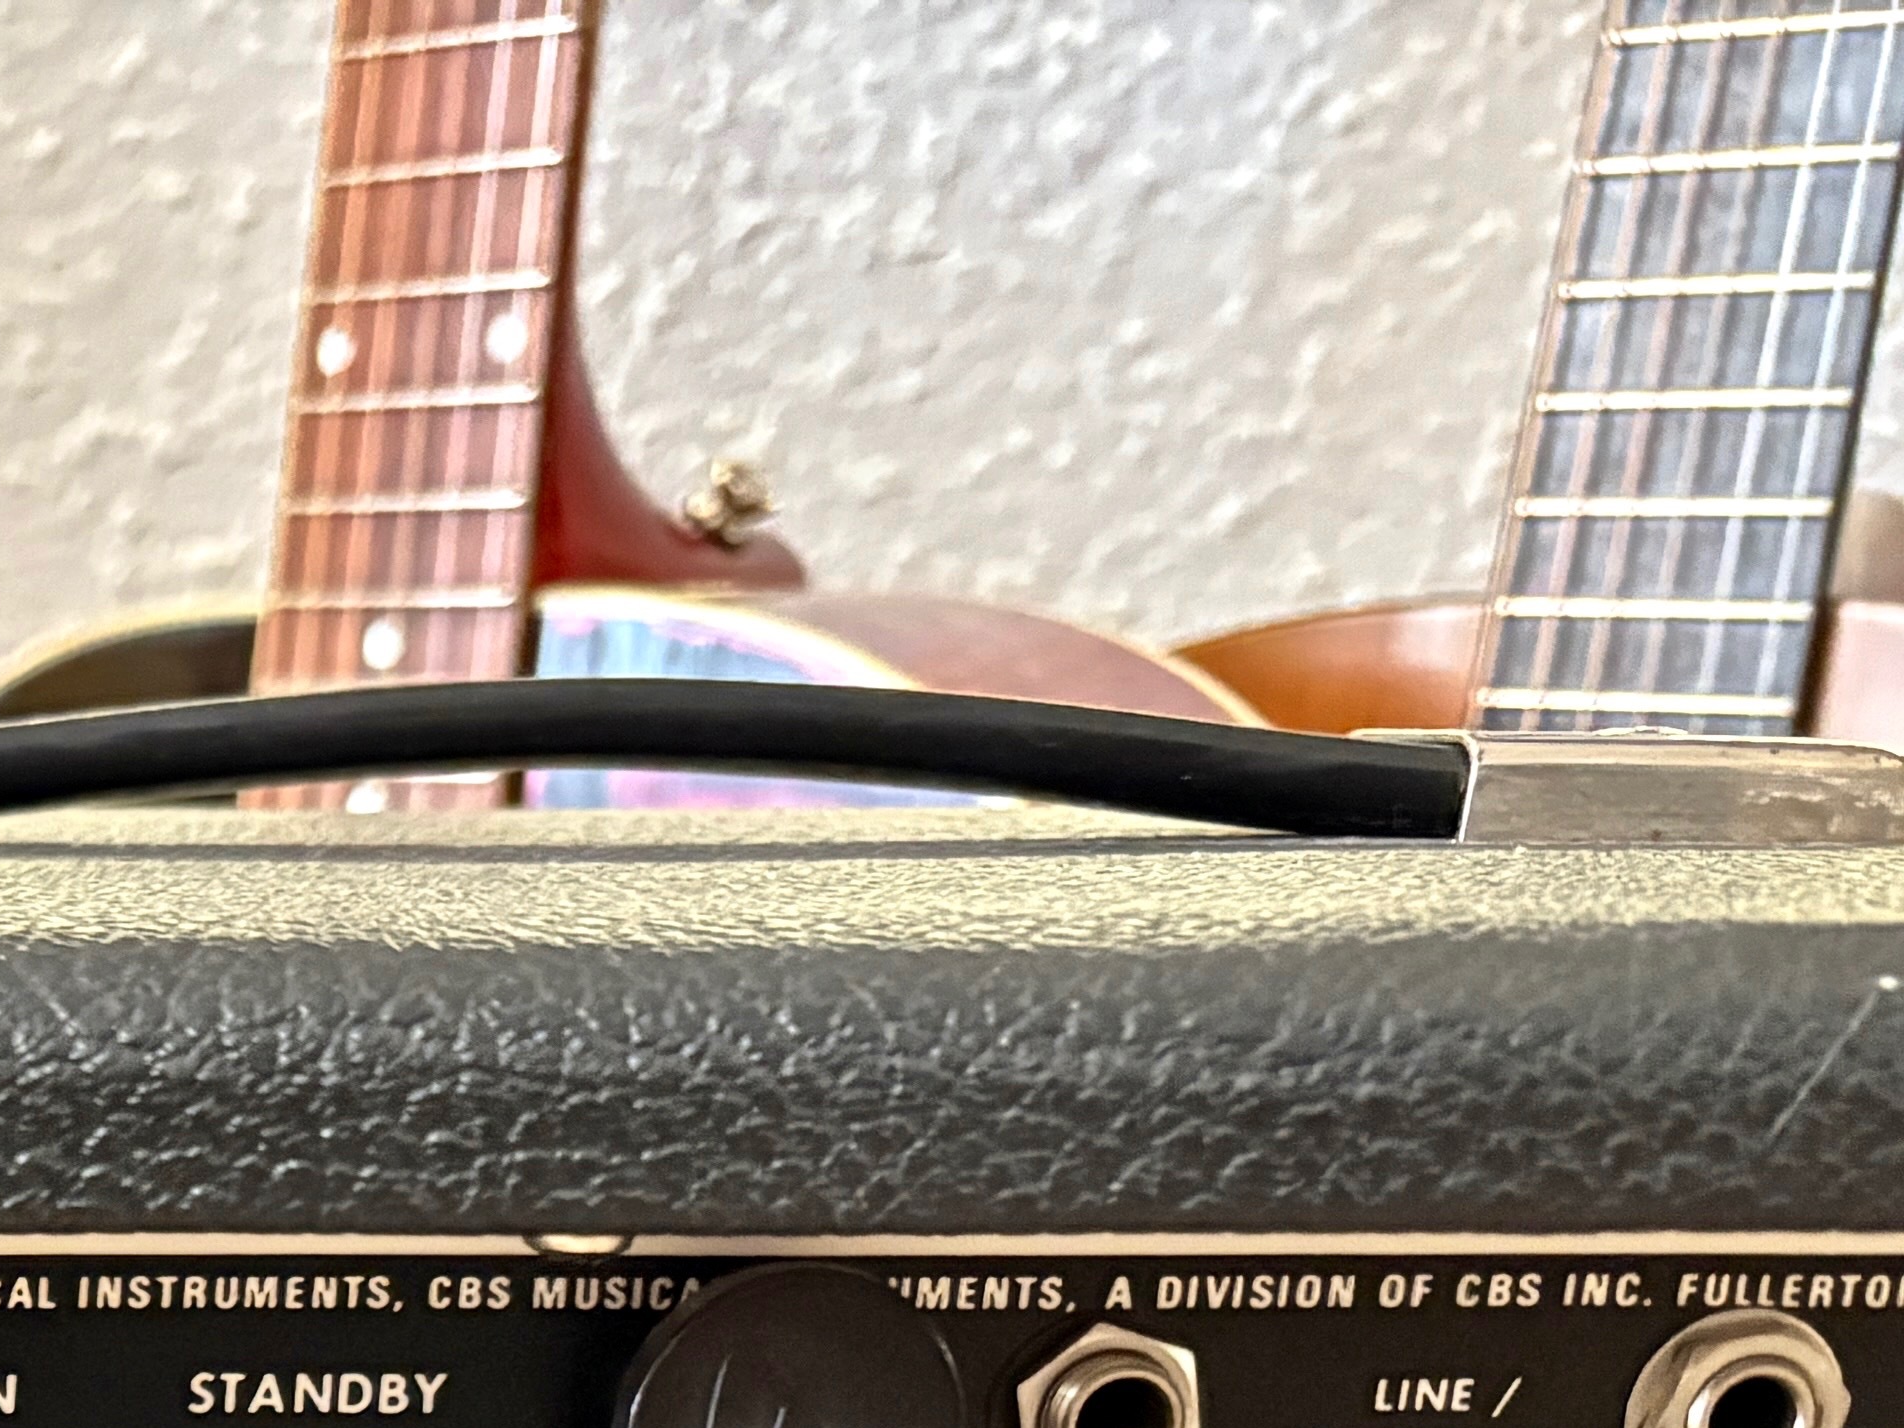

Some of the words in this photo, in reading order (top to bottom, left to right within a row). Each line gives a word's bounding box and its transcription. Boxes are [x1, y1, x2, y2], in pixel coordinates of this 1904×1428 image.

[77, 1275, 405, 1313] INSTRUMENTS,
[427, 1275, 512, 1311] CBS
[1103, 1276, 1133, 1310] A
[1155, 1274, 1357, 1310] DIVISION
[1378, 1273, 1435, 1309] OF
[1455, 1272, 1543, 1308] CBS
[1562, 1272, 1653, 1308] INC.
[1676, 1272, 1904, 1308] FULLERTO
[187, 1371, 449, 1415] STANDBY
[1373, 1376, 1477, 1413] LINE
